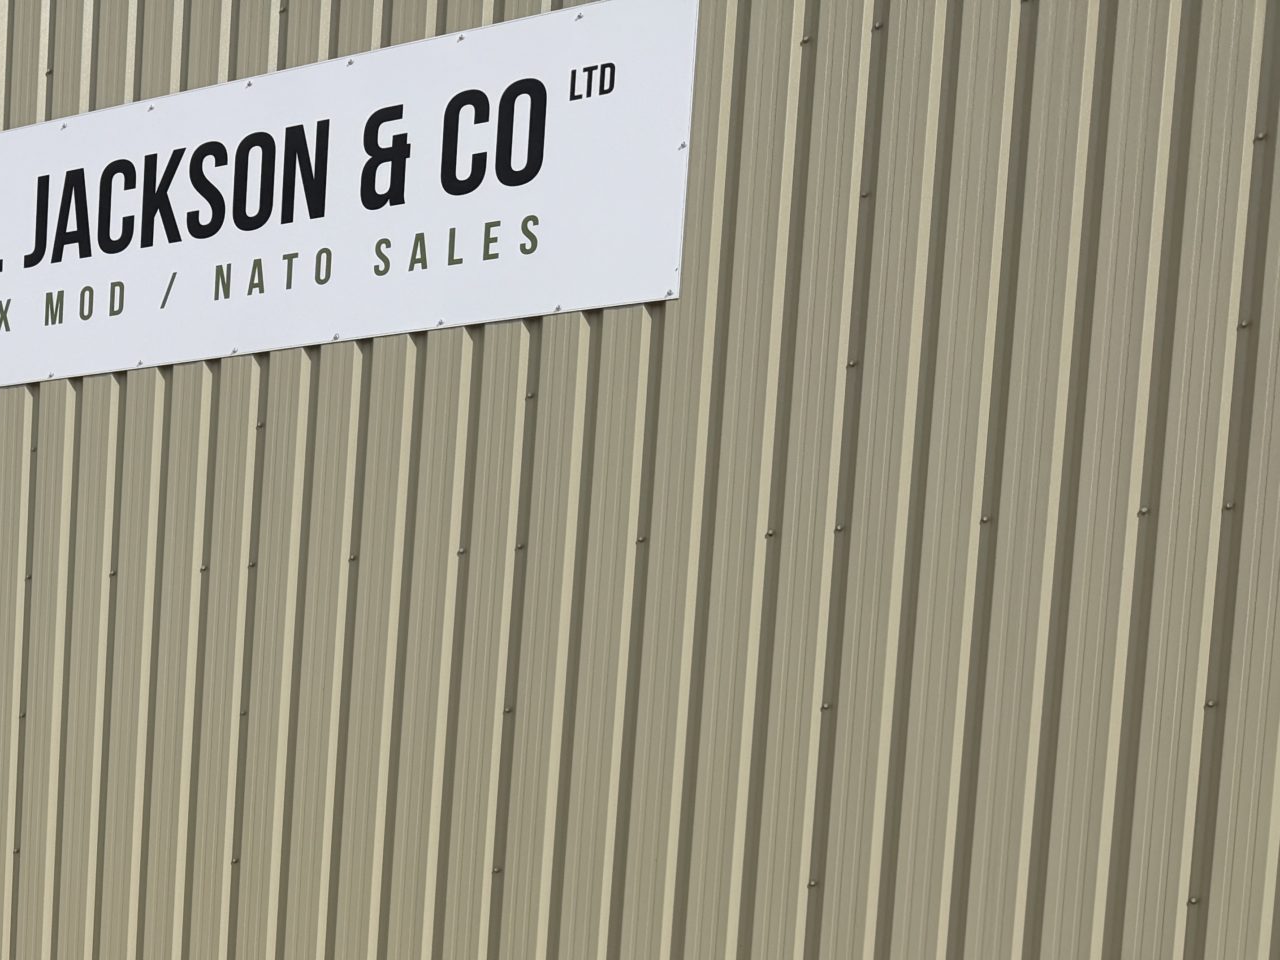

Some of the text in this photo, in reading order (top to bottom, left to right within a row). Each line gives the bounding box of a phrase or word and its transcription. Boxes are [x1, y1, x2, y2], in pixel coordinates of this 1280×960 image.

[23, 118, 331, 269] JACKSON
[359, 103, 412, 211] &
[440, 77, 548, 197] CO
[569, 62, 616, 102] LTD
[44, 281, 125, 327] MOD
[213, 247, 332, 301] NATO
[373, 214, 540, 277] SALES
